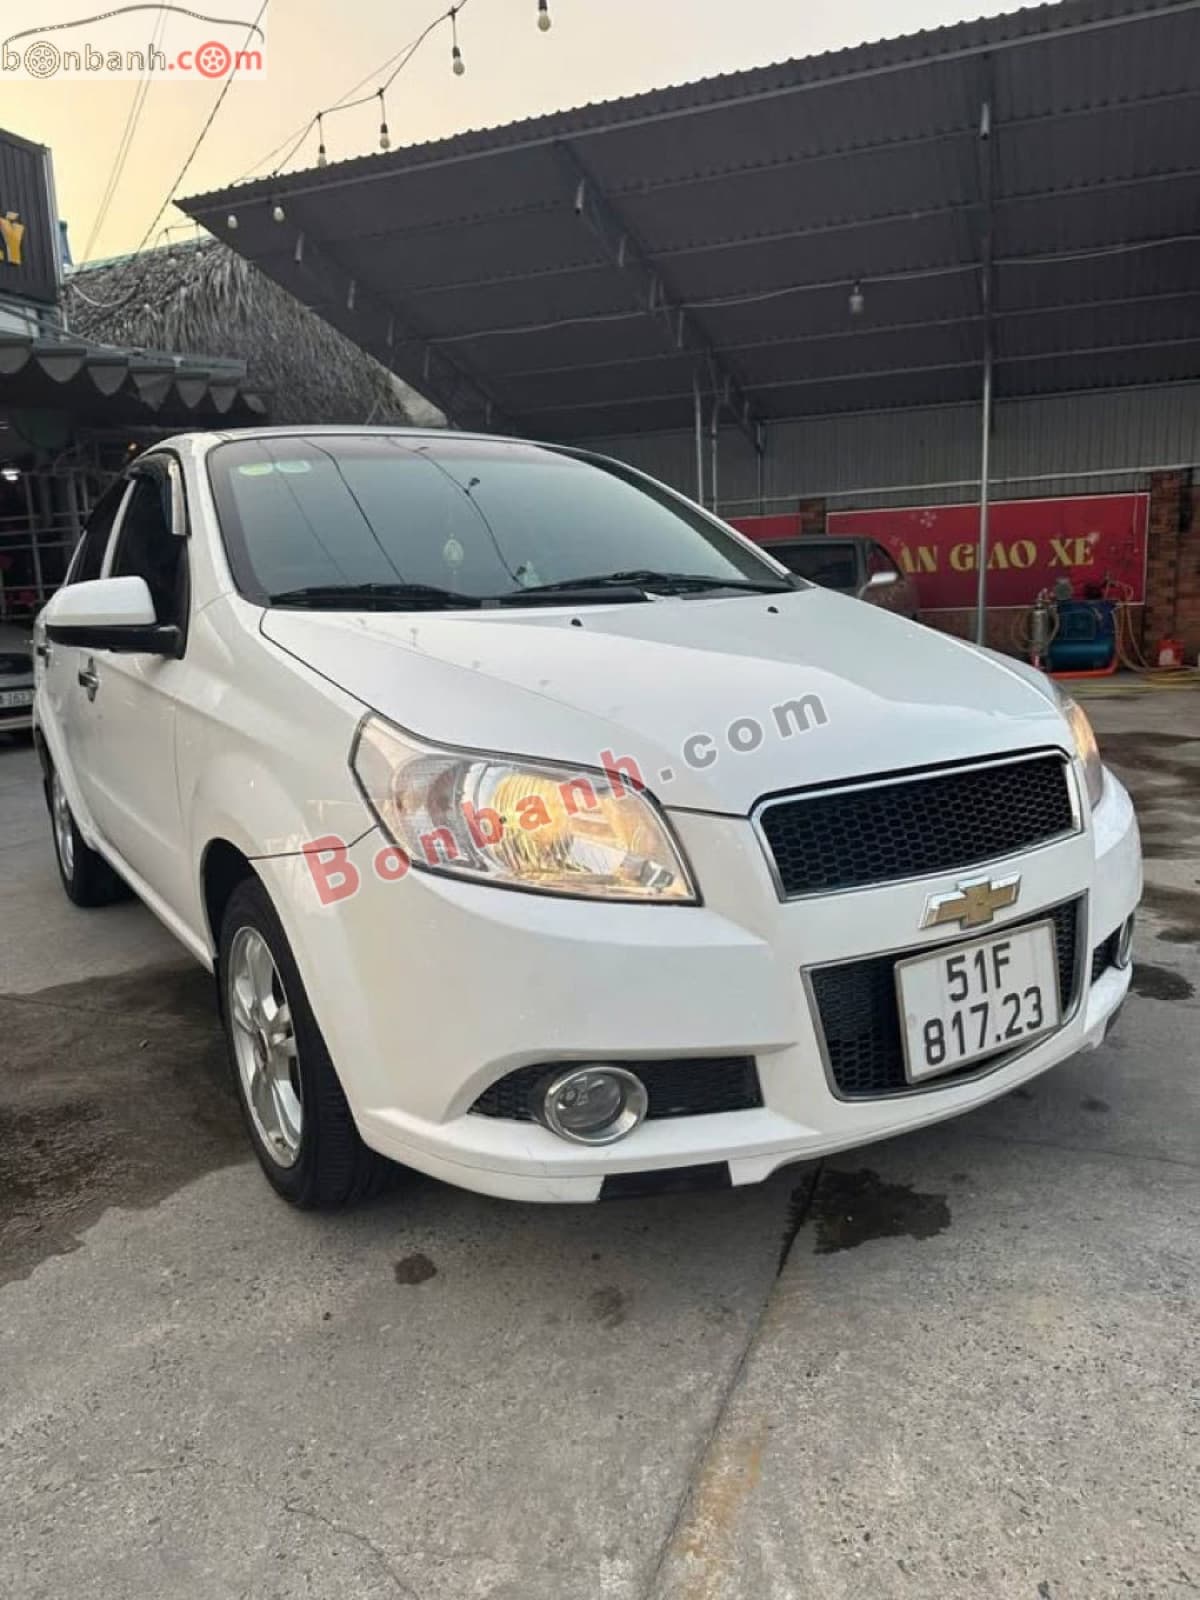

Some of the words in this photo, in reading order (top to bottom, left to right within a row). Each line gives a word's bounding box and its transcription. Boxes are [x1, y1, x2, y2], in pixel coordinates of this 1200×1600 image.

[1048, 536, 1094, 567] XE
[946, 942, 1011, 1002] 51F
[923, 986, 1043, 1066] 817.23
